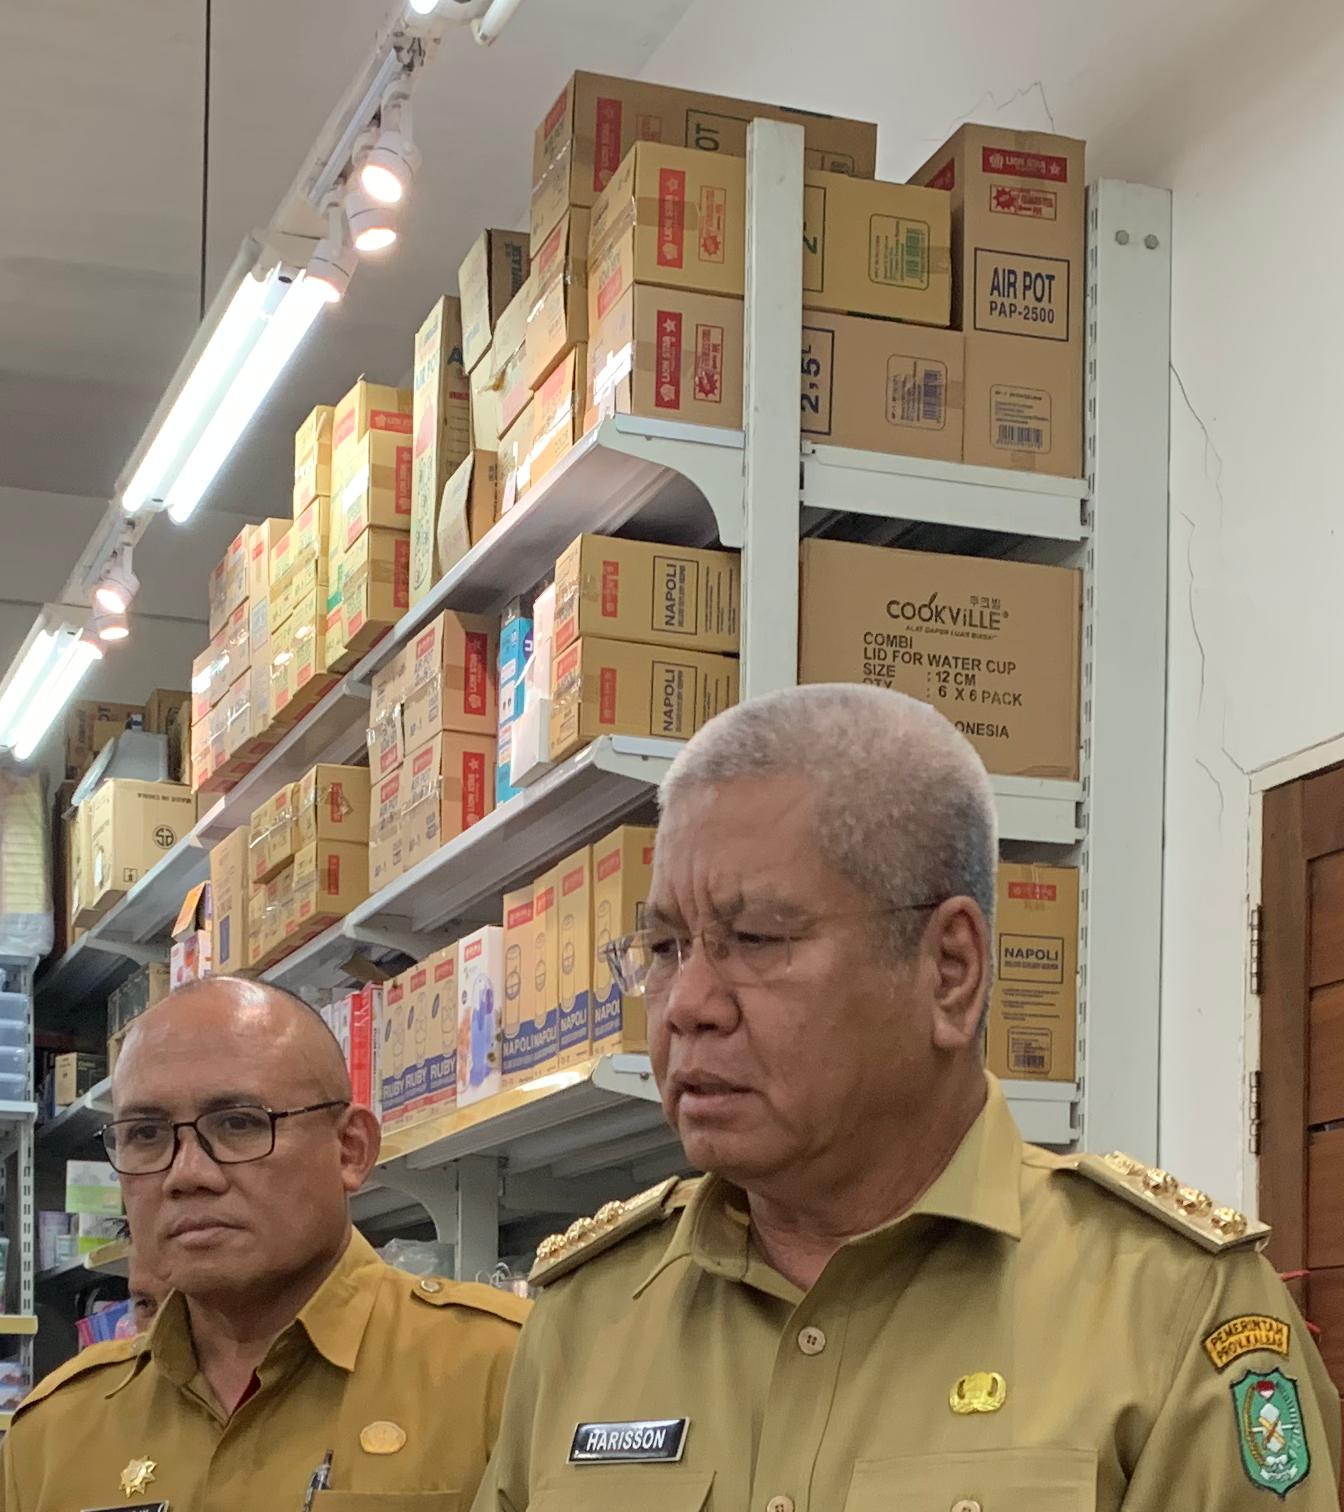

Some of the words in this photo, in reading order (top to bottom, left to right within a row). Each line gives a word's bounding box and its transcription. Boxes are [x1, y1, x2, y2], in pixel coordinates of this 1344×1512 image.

[696, 123, 718, 150] OT
[990, 267, 1017, 298] AIR
[1023, 270, 1056, 303] POT
[989, 301, 1055, 324] PAP-2500
[665, 563, 677, 627] NAPOLI
[864, 632, 913, 650] COMBI
[864, 647, 888, 662] LID
[893, 651, 923, 667] FOR
[928, 653, 982, 673] WATER
[987, 659, 1016, 676] CUP
[863, 663, 896, 678] SIZE
[936, 671, 951, 685] 12
[954, 672, 977, 687] CM
[663, 669, 675, 731] NAPOLI
[938, 686, 947, 698] 6
[969, 689, 978, 702] 6
[981, 690, 1023, 706] PACK
[954, 721, 1009, 738] ONESIA
[1004, 947, 1059, 962] NAPOLI
[561, 1010, 587, 1030] NAPOLI
[406, 1068, 427, 1087] RUBY
[430, 1056, 456, 1079] RUBY
[383, 1079, 405, 1096] RUBY
[586, 1429, 666, 1451] HARISSON
